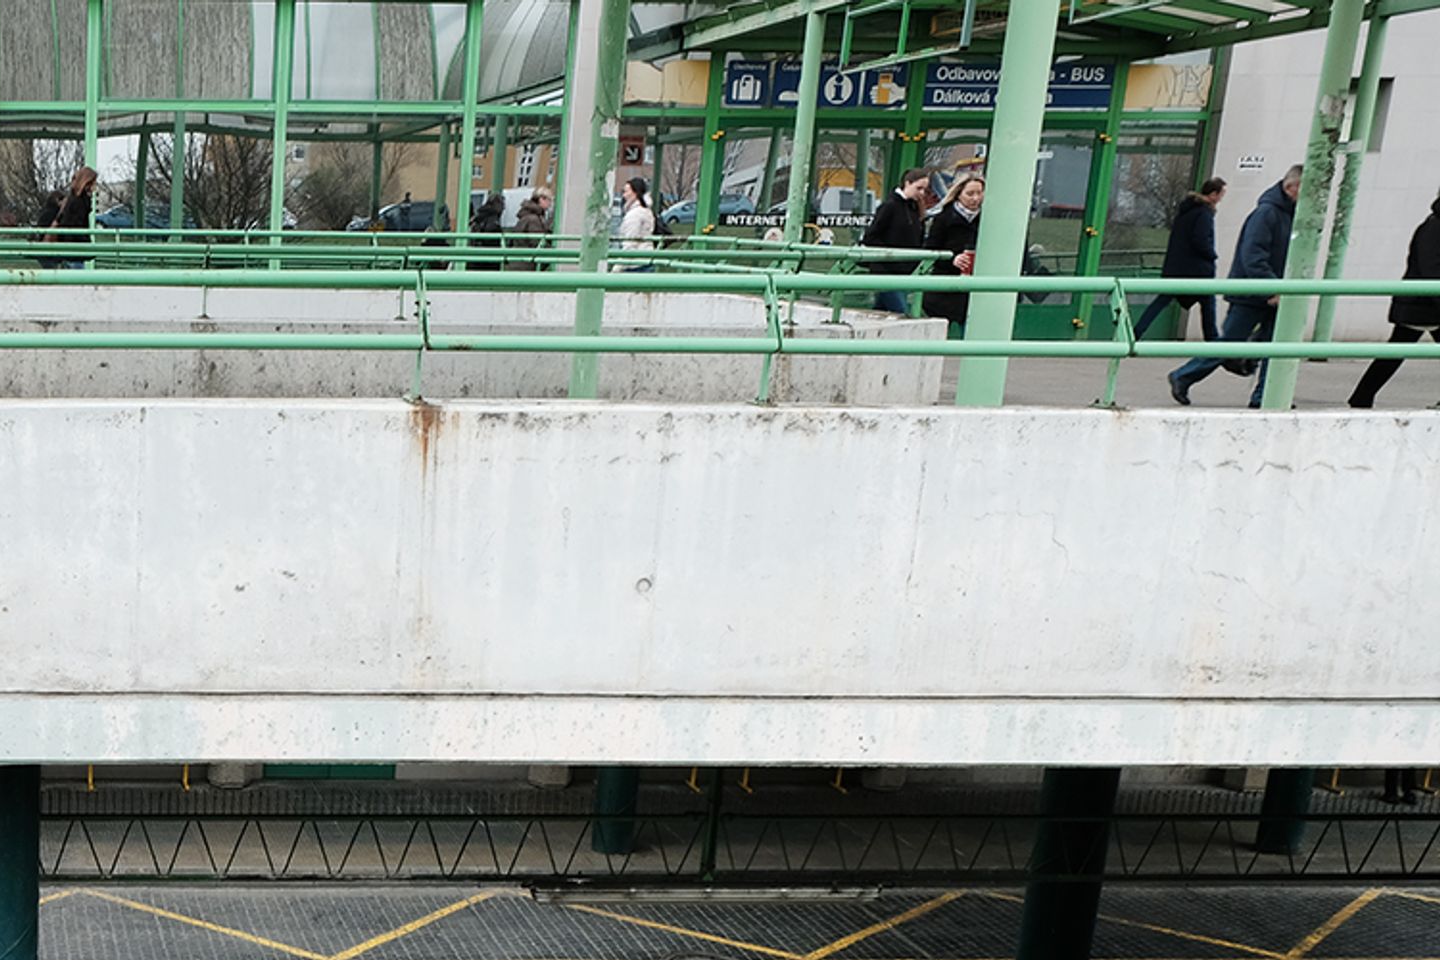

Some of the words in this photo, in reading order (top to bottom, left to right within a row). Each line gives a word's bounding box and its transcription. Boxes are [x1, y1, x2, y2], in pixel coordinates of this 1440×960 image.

[936, 66, 1002, 81] Odbavov
[1070, 66, 1106, 82] BUS
[933, 88, 991, 104] Dálková
